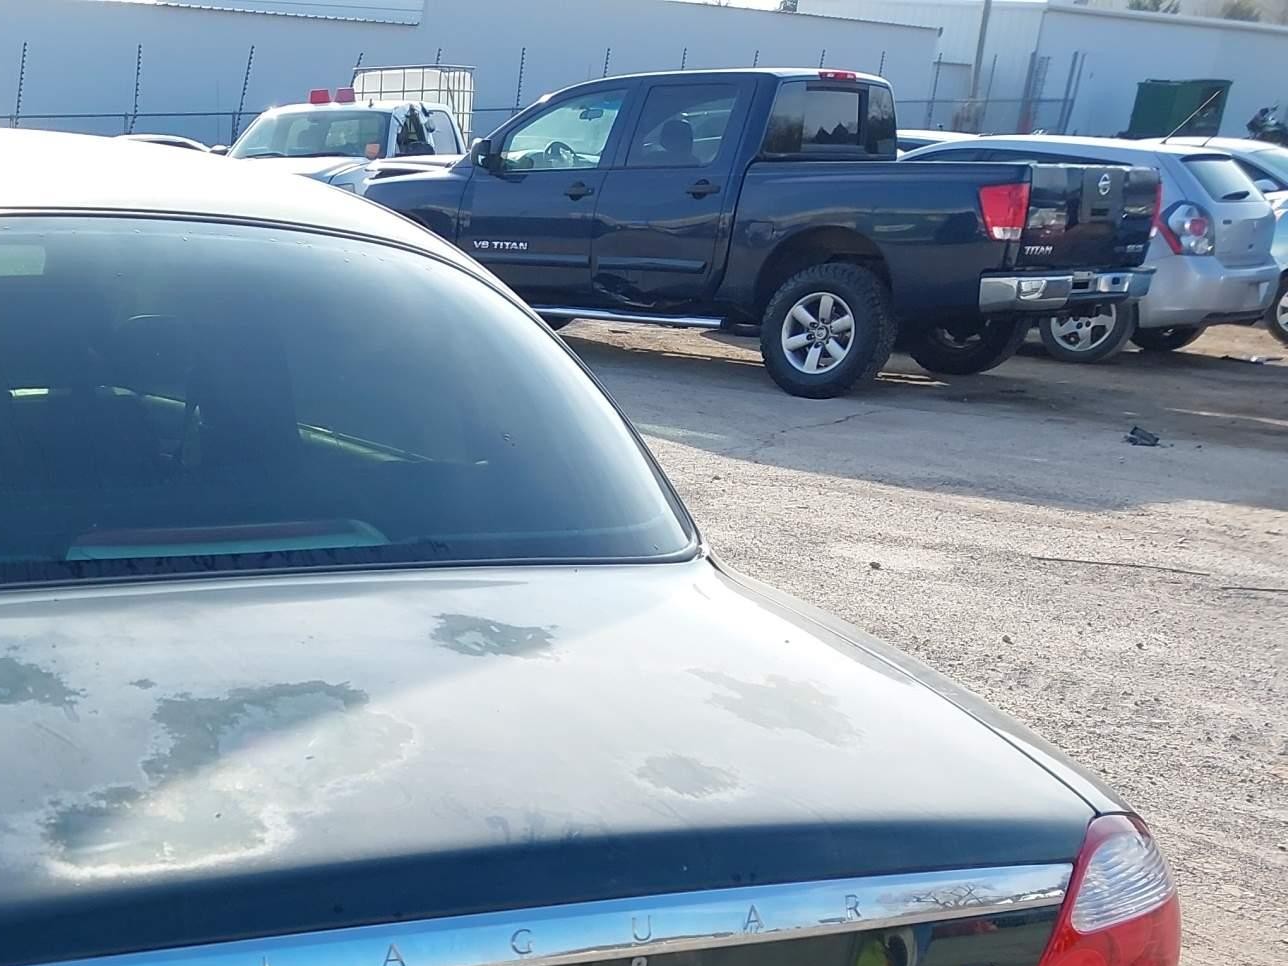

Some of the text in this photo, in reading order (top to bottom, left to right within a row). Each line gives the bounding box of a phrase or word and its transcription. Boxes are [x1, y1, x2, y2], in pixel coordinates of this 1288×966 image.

[473, 240, 528, 250] V8 TITAN
[1024, 245, 1053, 255] TITAN
